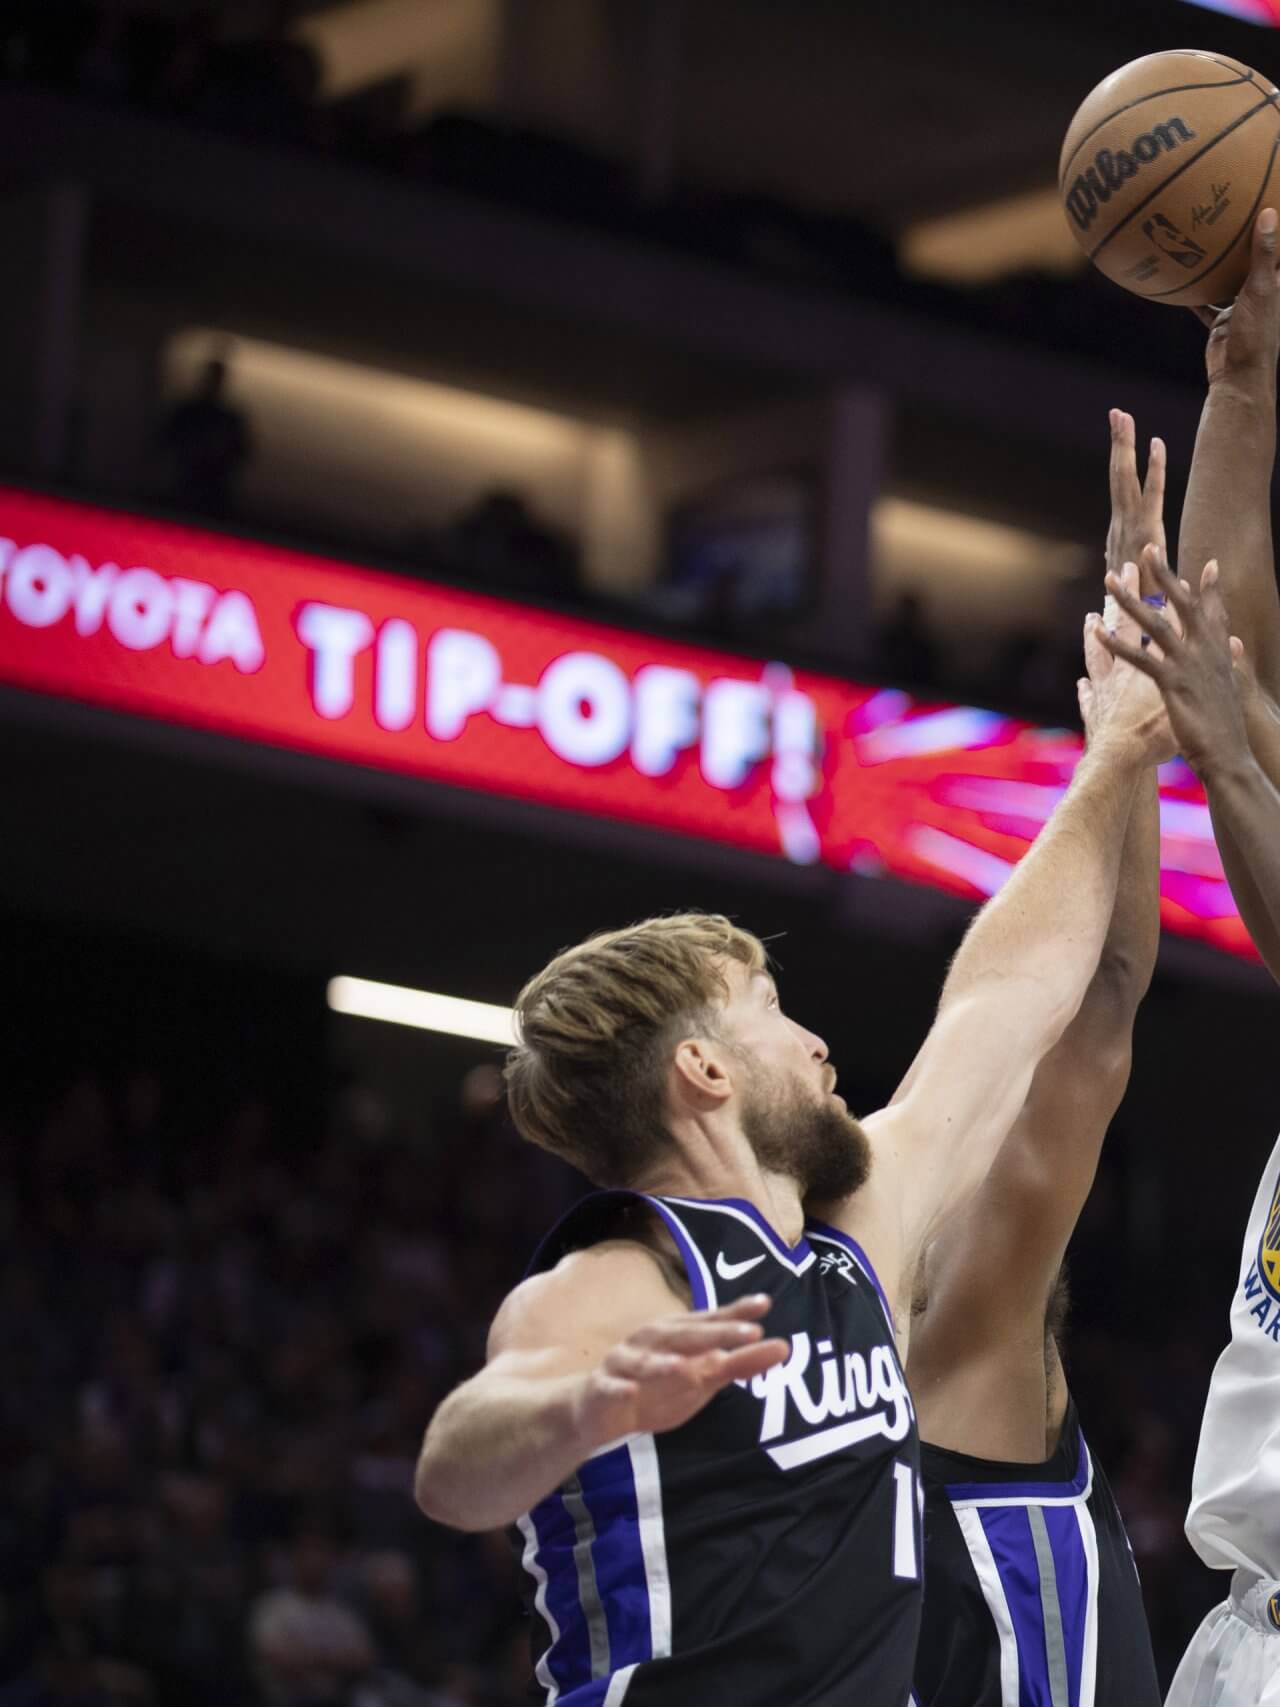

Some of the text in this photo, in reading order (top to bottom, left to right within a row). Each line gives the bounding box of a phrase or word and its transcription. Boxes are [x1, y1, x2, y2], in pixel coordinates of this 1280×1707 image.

[1066, 117, 1196, 232] Wilson
[295, 600, 821, 808] TIP-OFF!
[736, 1331, 915, 1471] King
[893, 1461, 925, 1579] 1
